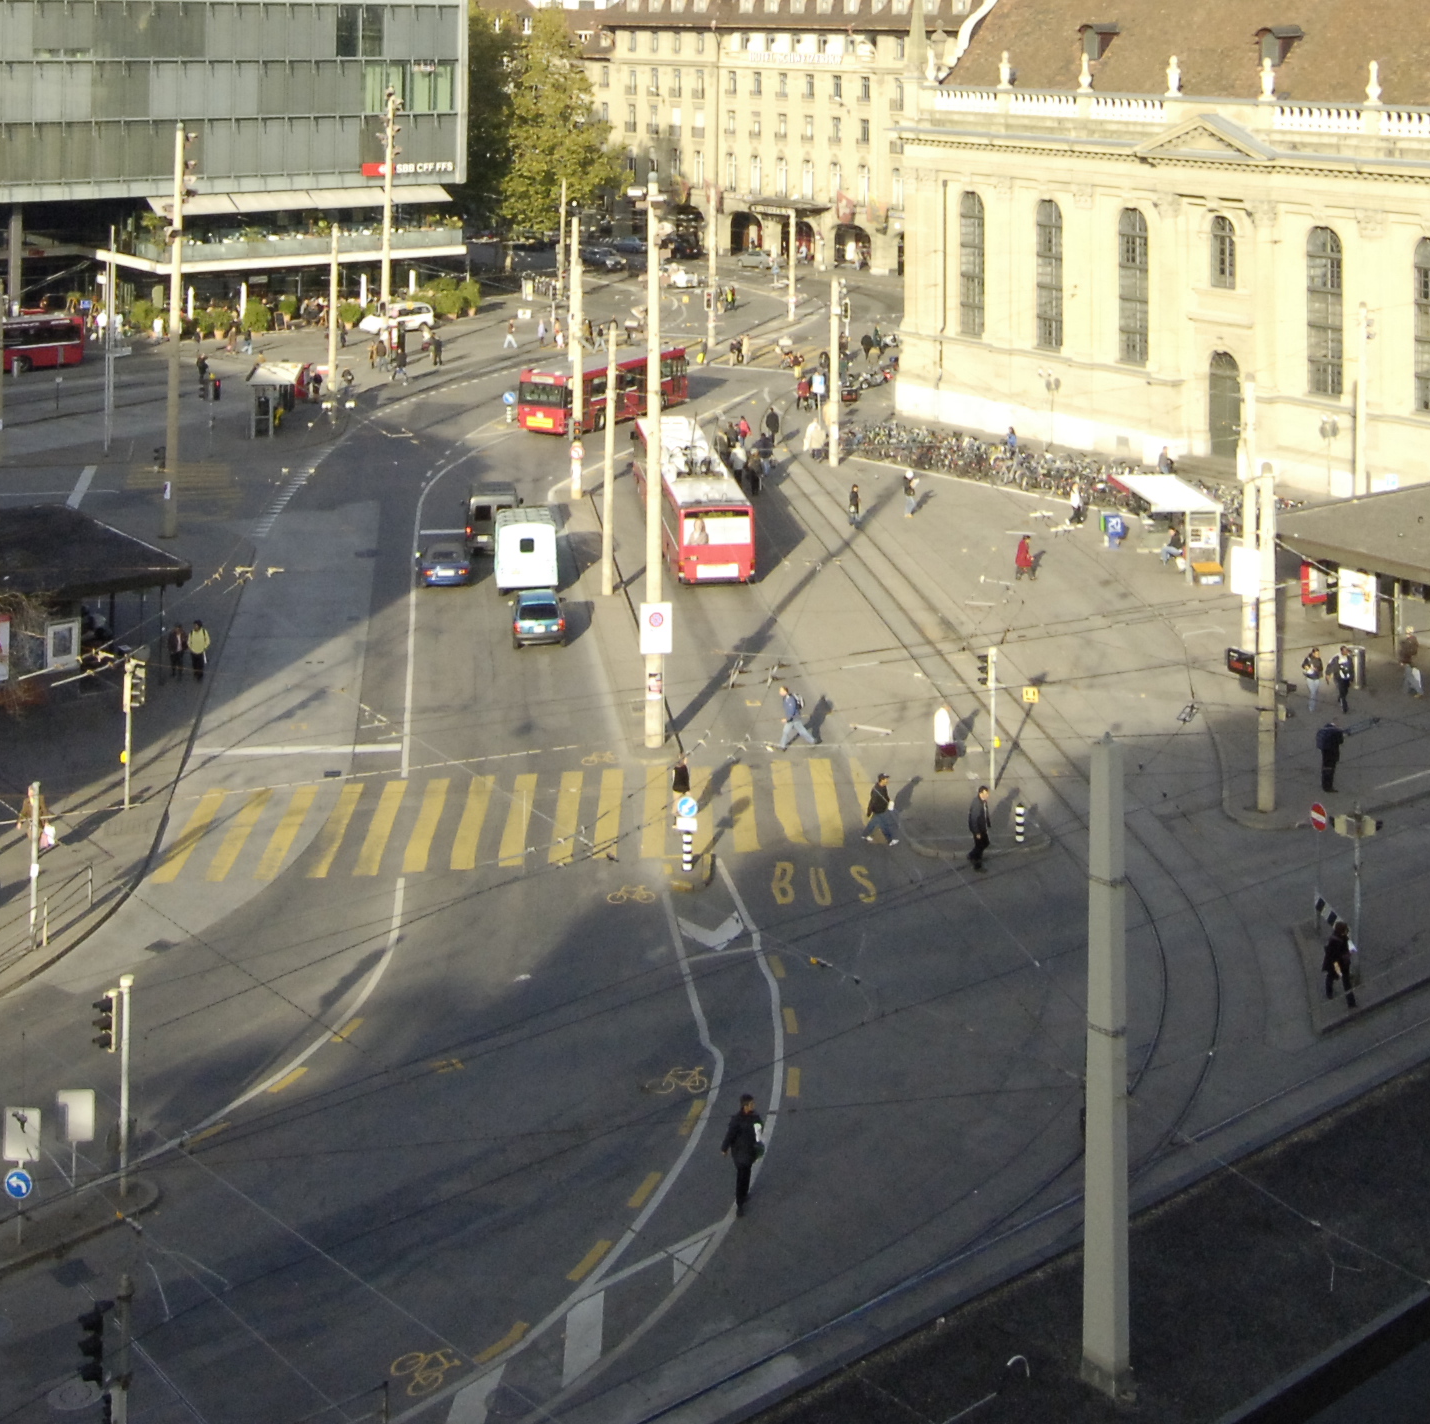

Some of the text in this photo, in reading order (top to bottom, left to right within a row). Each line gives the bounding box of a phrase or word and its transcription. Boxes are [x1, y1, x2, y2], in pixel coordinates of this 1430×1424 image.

[396, 161, 454, 174] SBB CFF FFS
[772, 861, 877, 906] BUS
